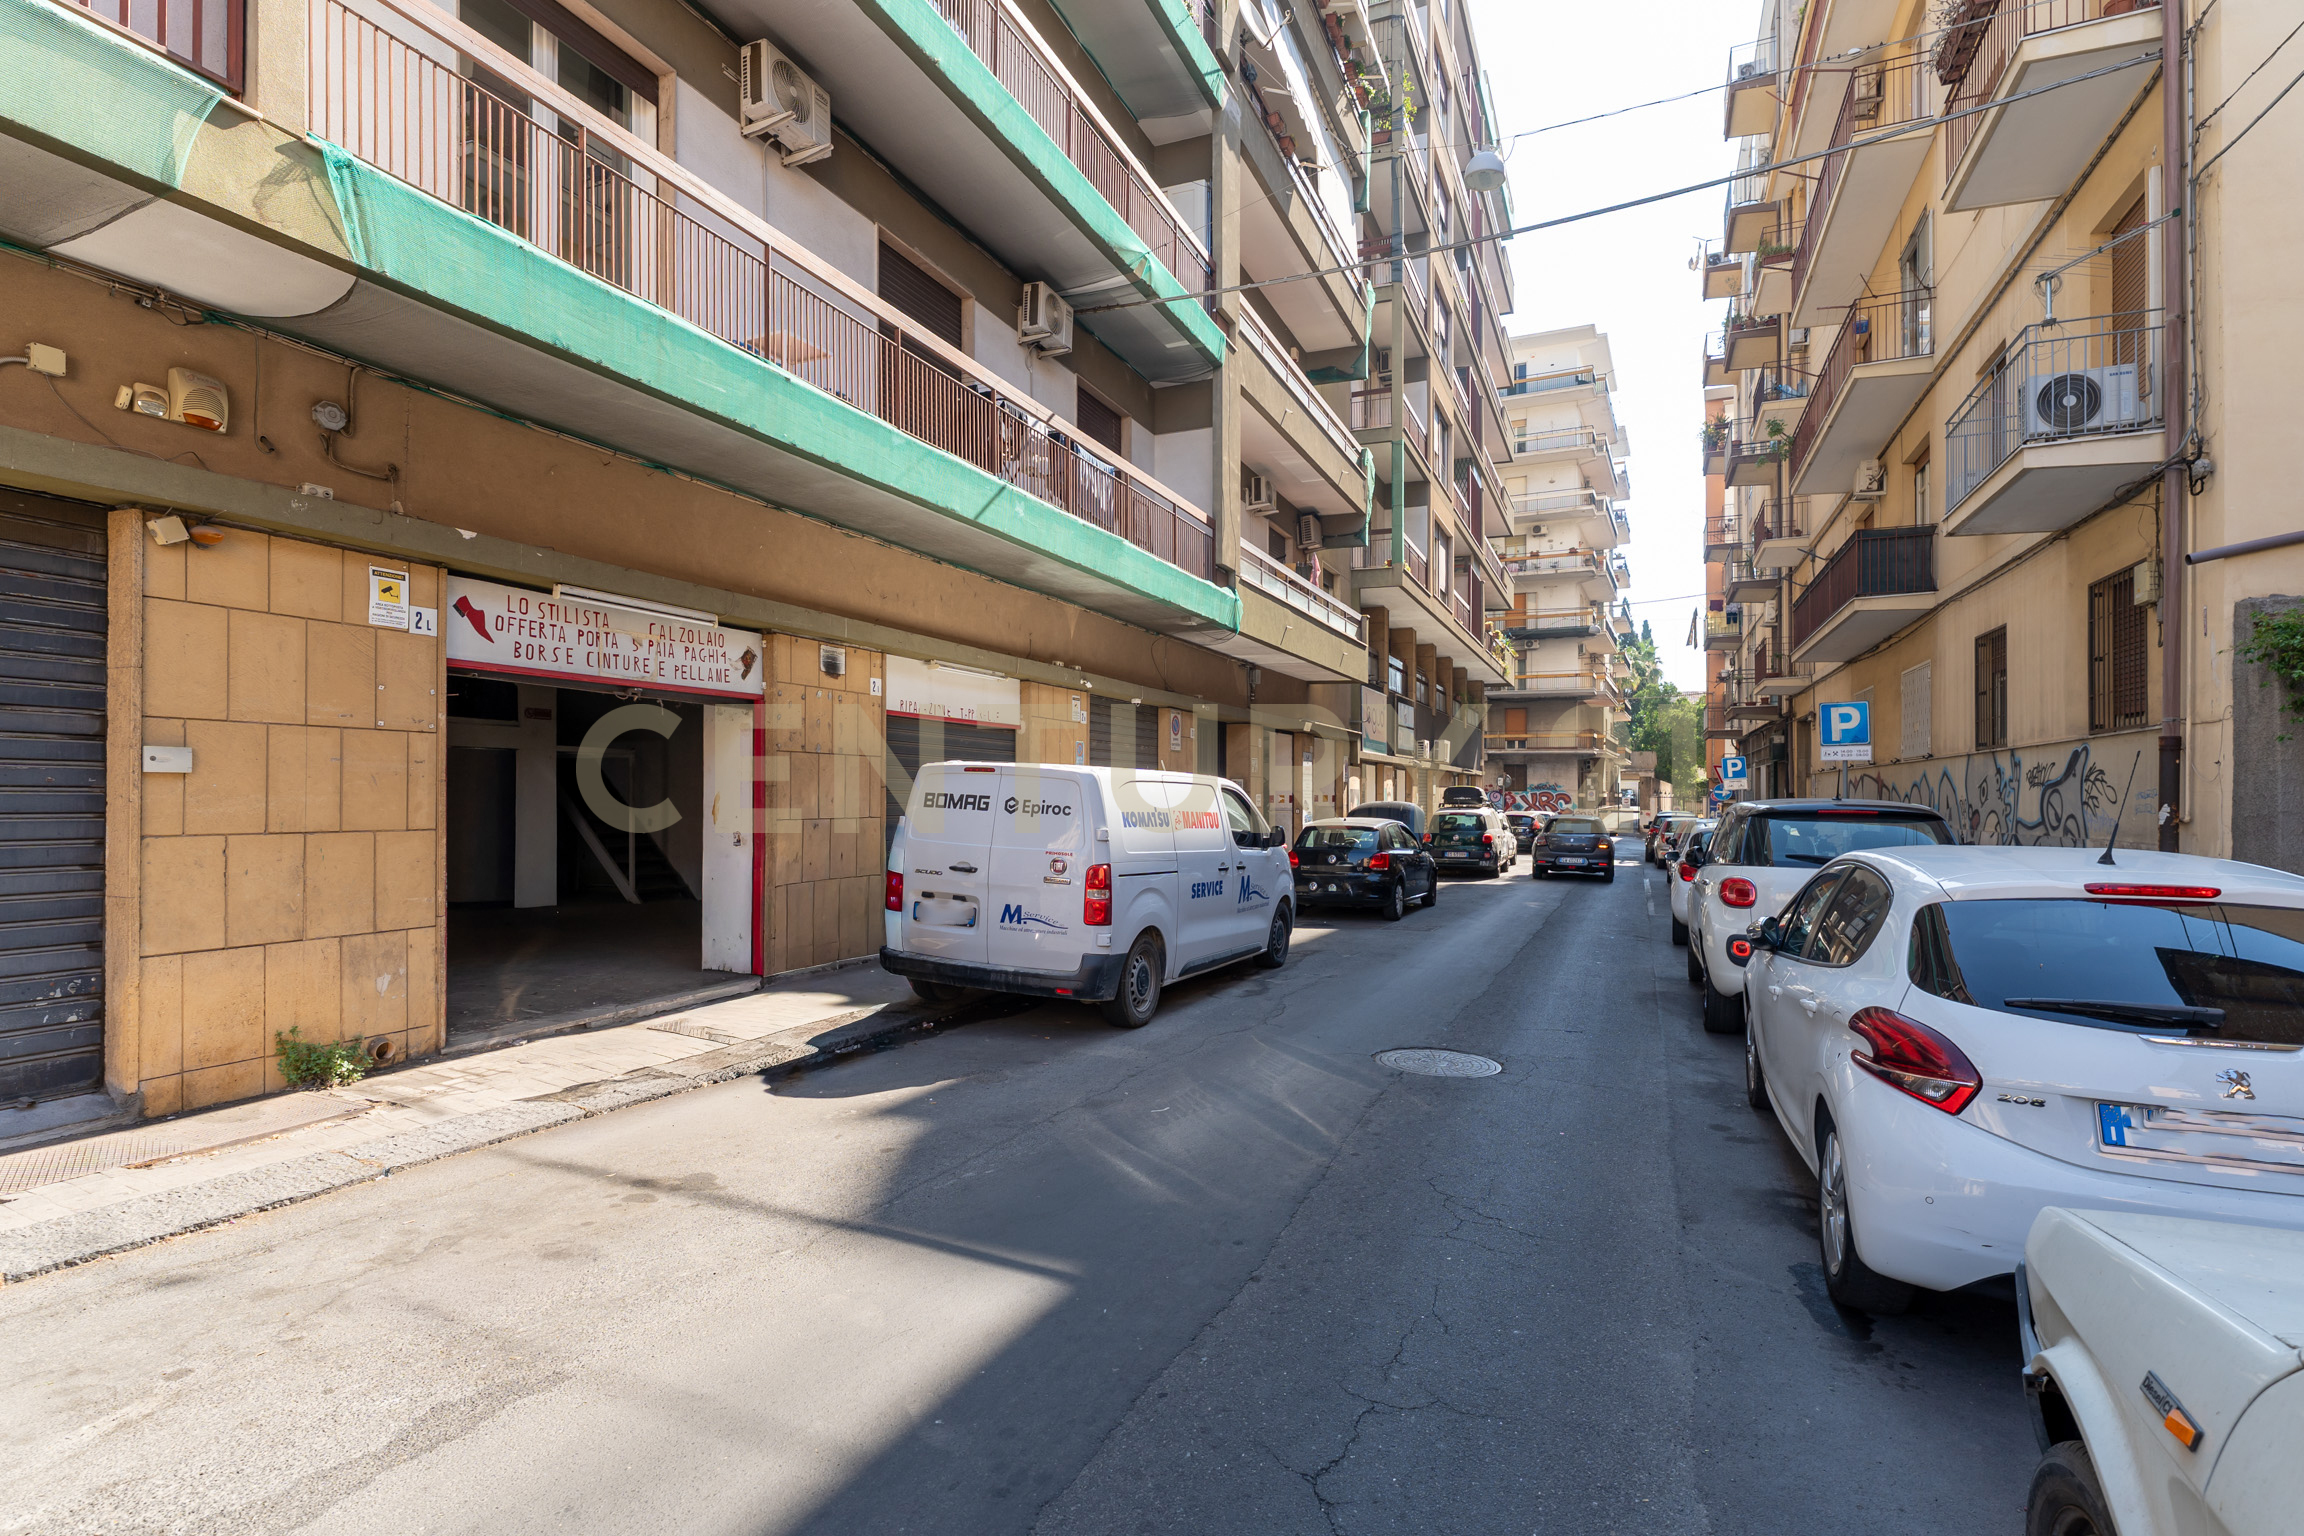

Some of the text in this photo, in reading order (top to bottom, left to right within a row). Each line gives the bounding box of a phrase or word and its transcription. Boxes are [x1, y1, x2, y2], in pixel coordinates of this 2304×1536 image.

[507, 594, 610, 629] LO STILISTA
[495, 614, 566, 643] OFFERTA
[577, 628, 619, 650] PORTA
[647, 639, 675, 659] PAIA
[513, 640, 731, 684] BORSE CINTURE E PELLAME
[1830, 706, 1861, 742] P
[1726, 758, 1743, 778] P
[923, 792, 991, 811] BOMAG
[1021, 799, 1072, 818] Epiroc
[1121, 807, 1170, 828] KOMATSU
[1182, 811, 1220, 830] MANITOU
[1191, 880, 1223, 899] SERVICE
[1022, 911, 1059, 925] Service
[1996, 1093, 2047, 1108] 208
[2142, 1375, 2165, 1406] Diesel
